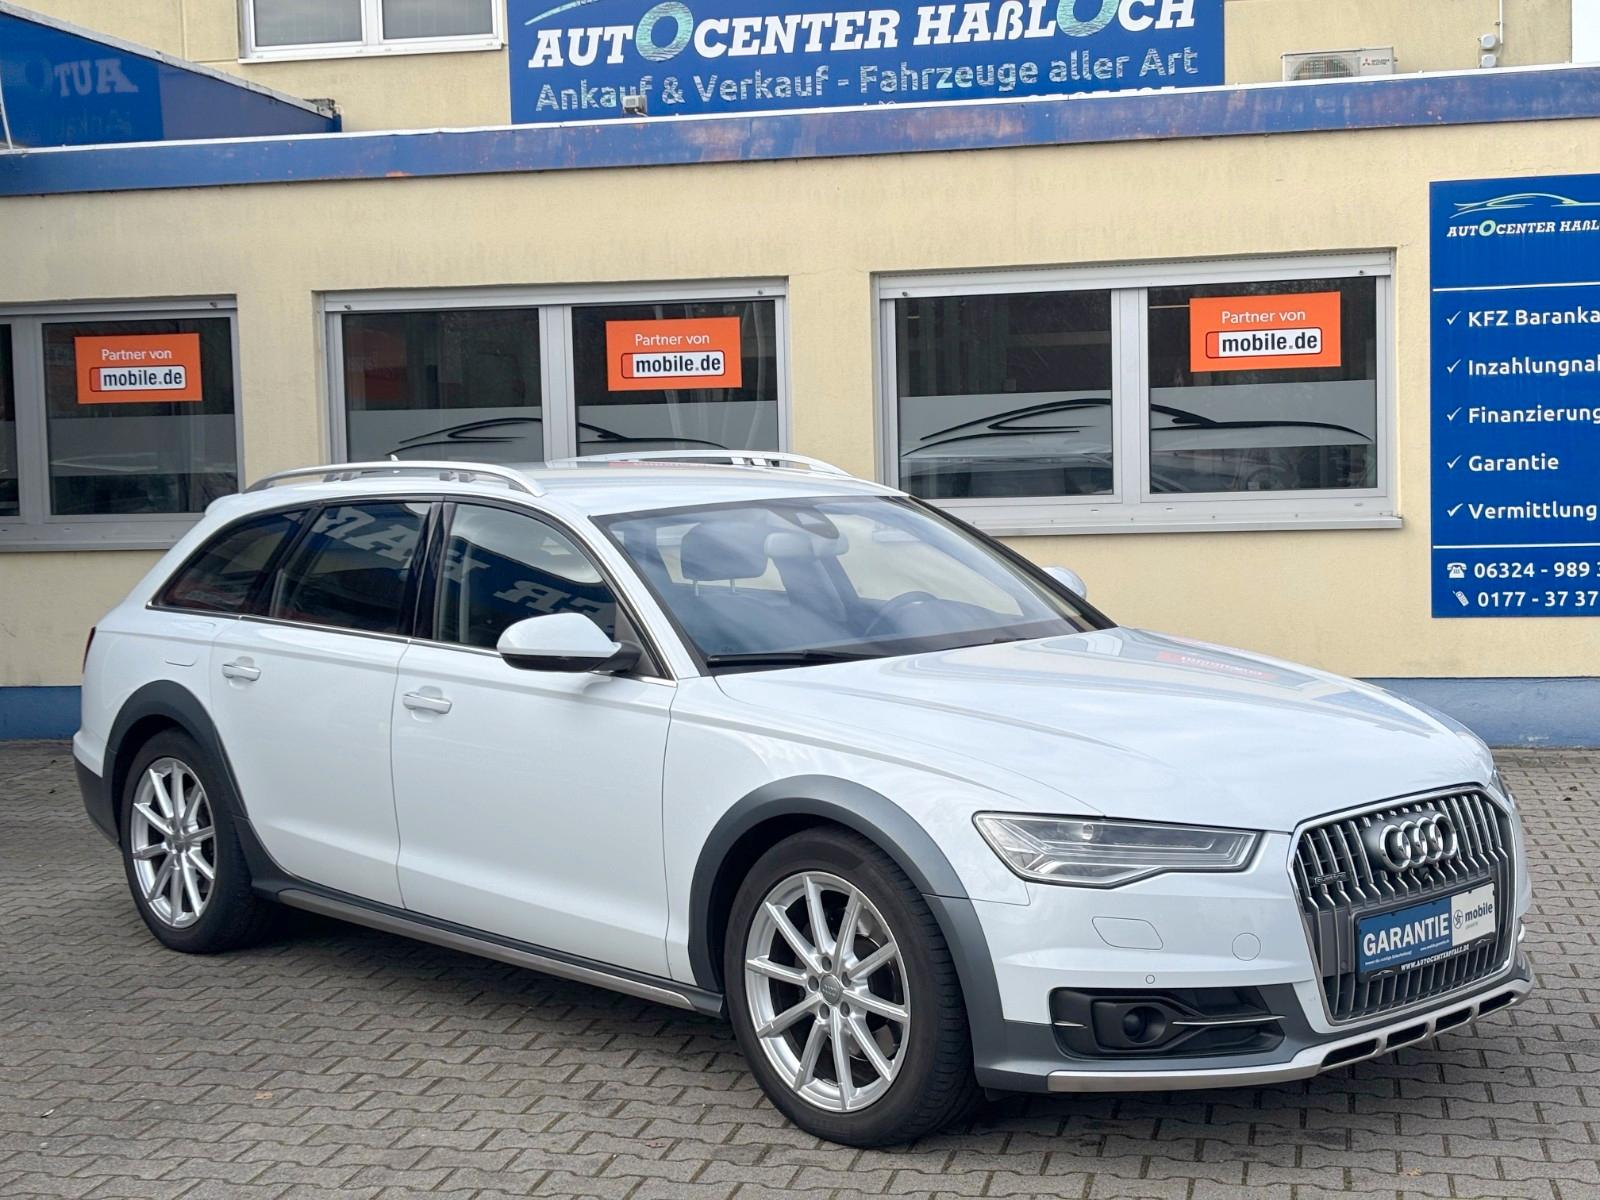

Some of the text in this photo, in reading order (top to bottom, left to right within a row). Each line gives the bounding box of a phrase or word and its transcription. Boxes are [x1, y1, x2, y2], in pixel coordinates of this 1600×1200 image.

[527, 1, 900, 68] AUTOCENTER
[535, 75, 653, 112] Ankauf
[661, 76, 686, 105] &
[692, 65, 830, 103] Verkauf
[837, 78, 849, 87] -
[859, 61, 1038, 93] Fahrzeuge
[1048, 50, 1130, 82] aller
[1138, 46, 1199, 77] Art
[1446, 219, 1556, 237] AUTOCENTER
[1221, 311, 1306, 324] Partner von
[1468, 310, 1509, 327] KFZ
[635, 334, 710, 346] Partner von
[1222, 332, 1318, 352] mobile.de
[101, 349, 172, 361] Partner von
[635, 354, 720, 373] mobile.de
[1468, 354, 1600, 376] Inzahlungna
[103, 369, 182, 387] mobile.de
[1468, 405, 1600, 424] Finanzierung
[1468, 453, 1559, 471] Garantie
[1468, 501, 1598, 521] Vermittlung
[1474, 562, 1535, 578] 06324
[1553, 561, 1591, 577] 989
[1477, 591, 1526, 607] 0177
[1544, 591, 1568, 607] 37
[1575, 591, 1599, 607] 37
[1464, 902, 1493, 921] mobile
[1363, 912, 1450, 957] GARANTIE
